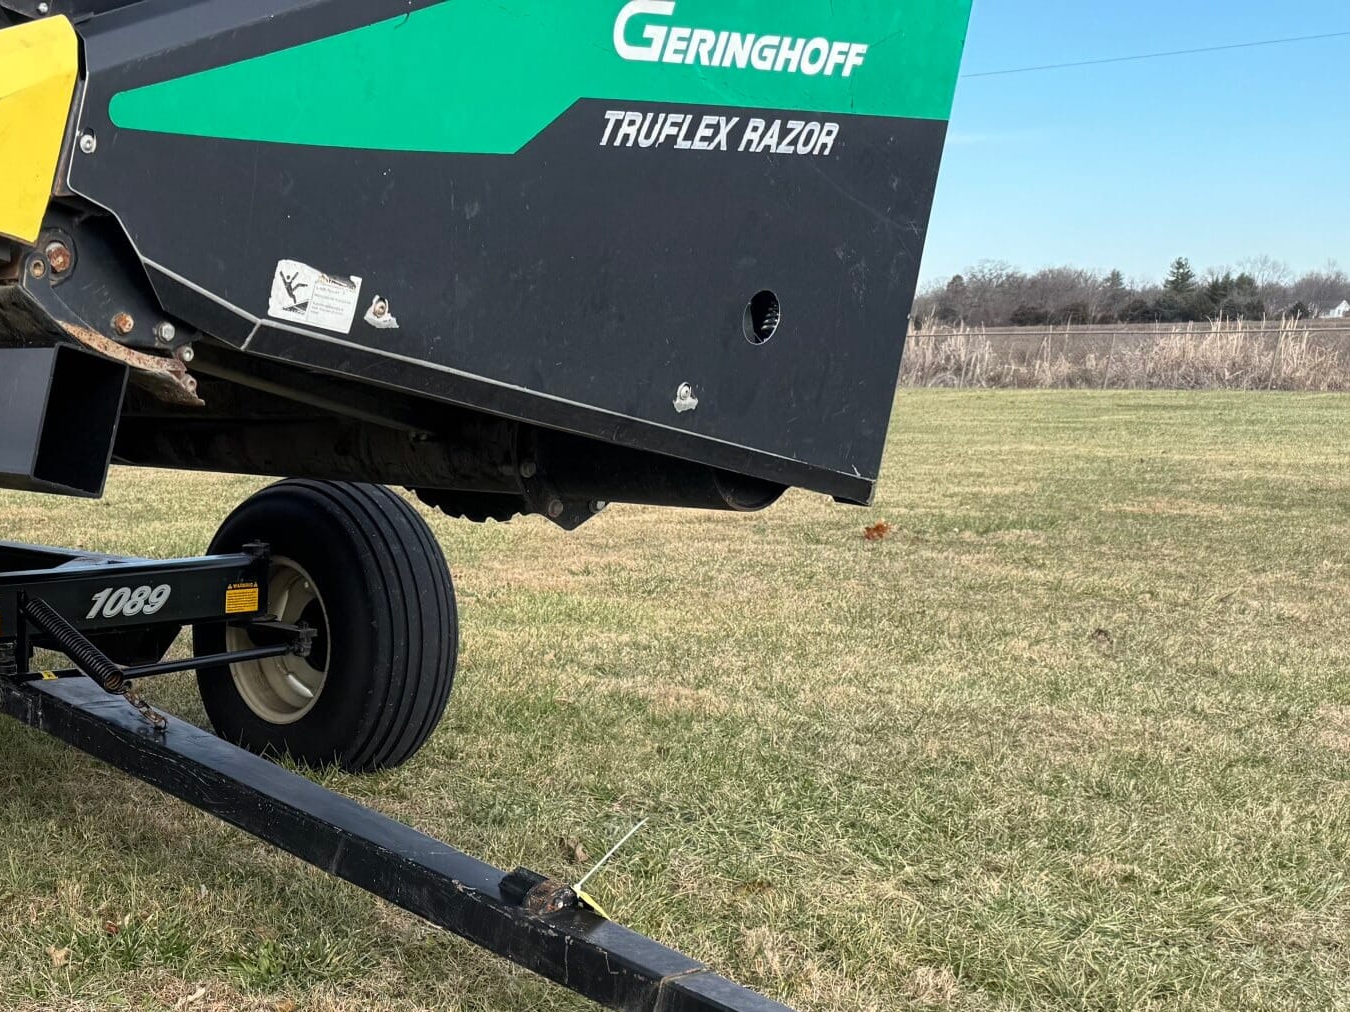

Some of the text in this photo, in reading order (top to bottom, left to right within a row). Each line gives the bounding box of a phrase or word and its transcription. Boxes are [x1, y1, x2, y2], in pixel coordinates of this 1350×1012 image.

[613, 0, 868, 77] GERINGHOFF
[600, 110, 840, 156] TRUFLEX RAZOR
[85, 583, 171, 619] 1089
